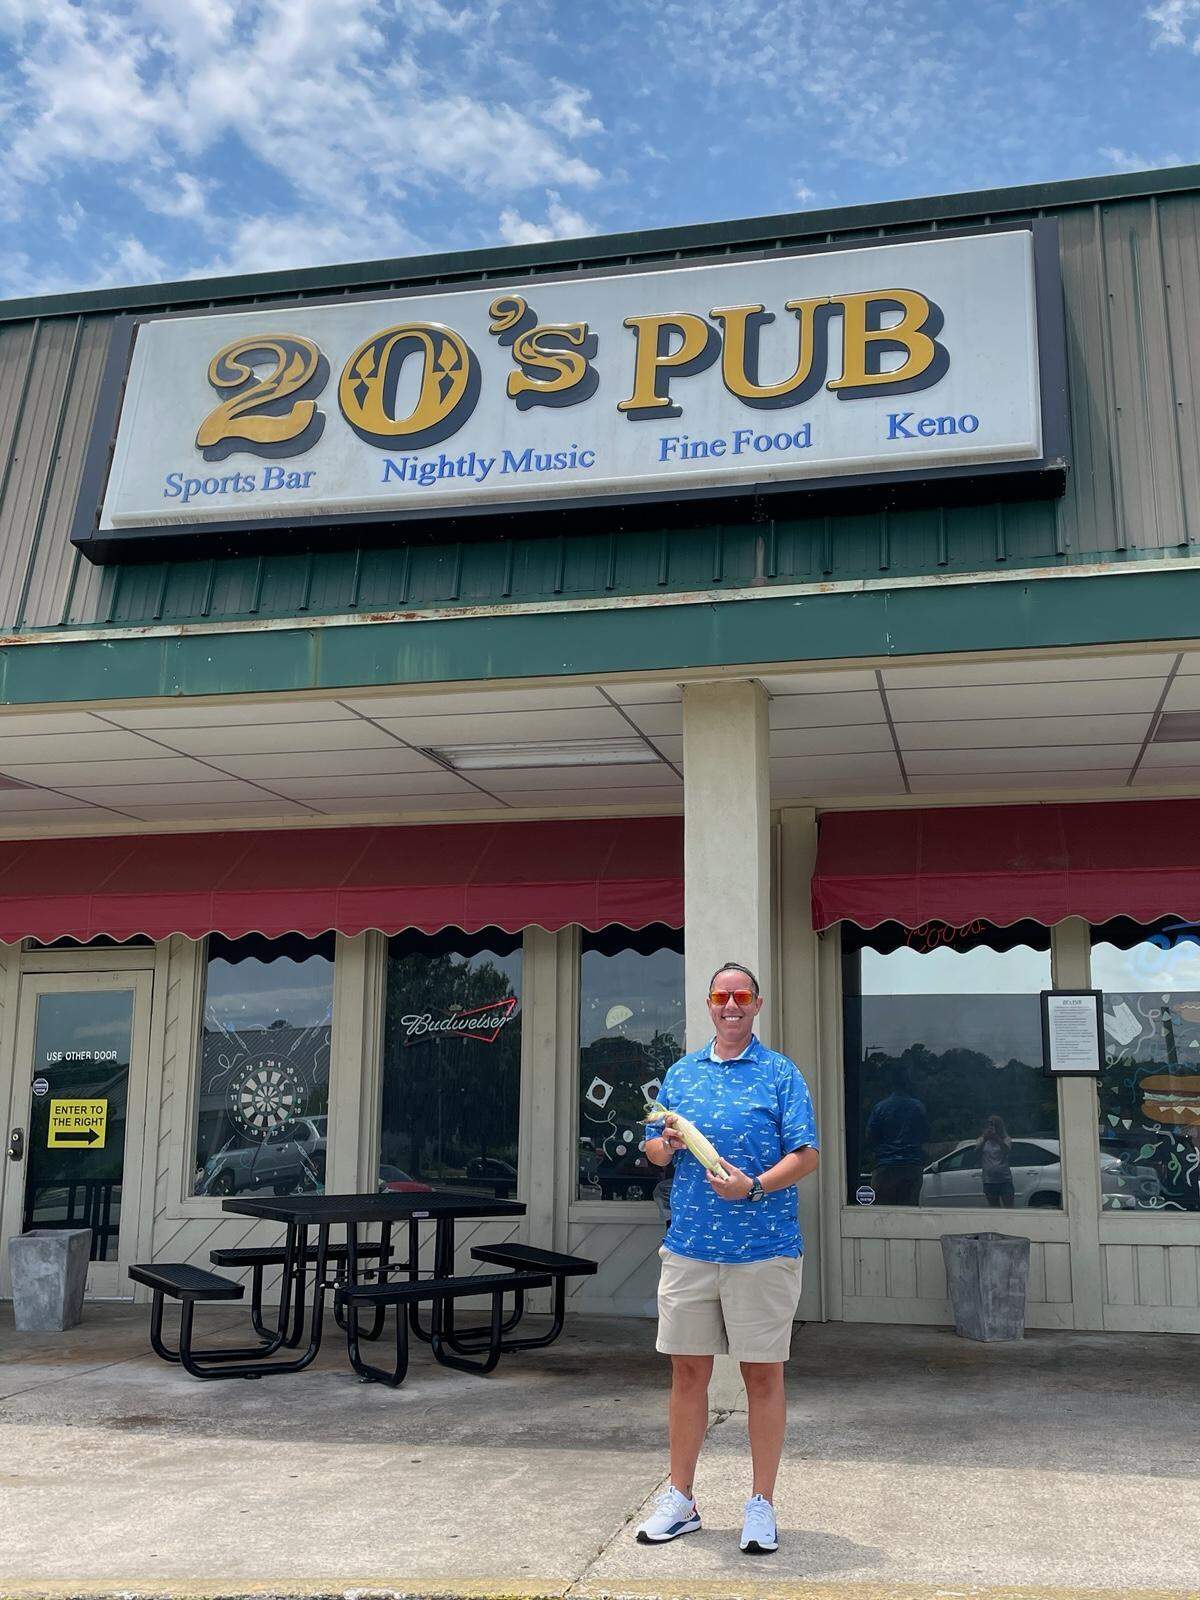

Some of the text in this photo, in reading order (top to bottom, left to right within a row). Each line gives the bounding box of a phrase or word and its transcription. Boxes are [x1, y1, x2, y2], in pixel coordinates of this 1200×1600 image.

[617, 288, 950, 421] PUB
[886, 411, 979, 440] Keno
[659, 423, 813, 462] Fine Food
[381, 443, 596, 488] Nightly Music
[164, 466, 316, 502] Sports Bar
[400, 1012, 513, 1036] Budweiser
[46, 1050, 117, 1061] USE OTHER DOOR
[53, 1117, 104, 1126] THE RIGHT
[55, 1105, 103, 1114] ENTER TO
